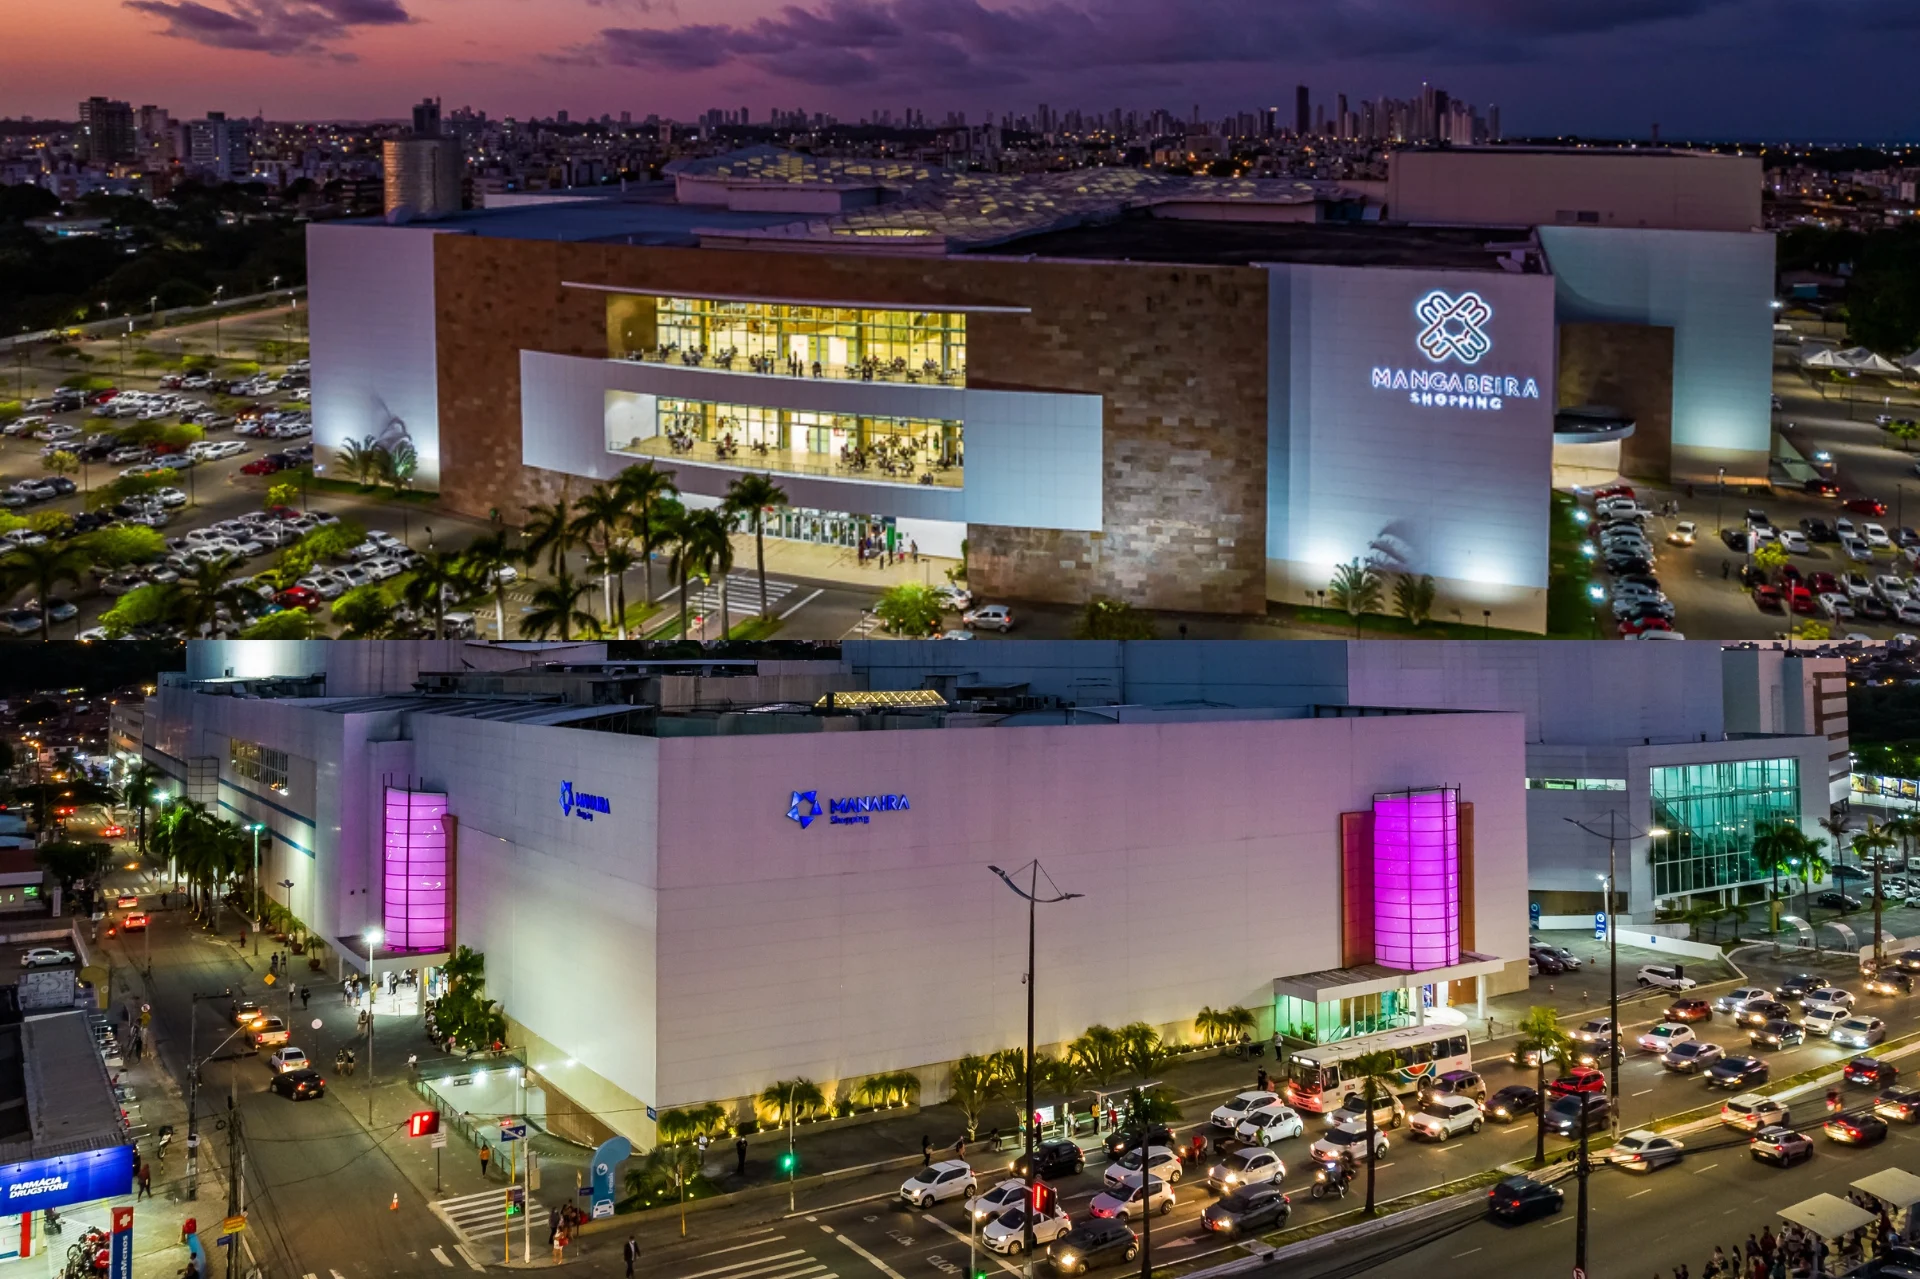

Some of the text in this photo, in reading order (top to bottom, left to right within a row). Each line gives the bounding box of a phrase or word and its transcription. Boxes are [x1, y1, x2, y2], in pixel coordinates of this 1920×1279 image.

[1371, 367, 1539, 398] MANGABEIRA
[1410, 391, 1502, 410] SHOPPING
[9, 1181, 69, 1199] DRUGSTORE
